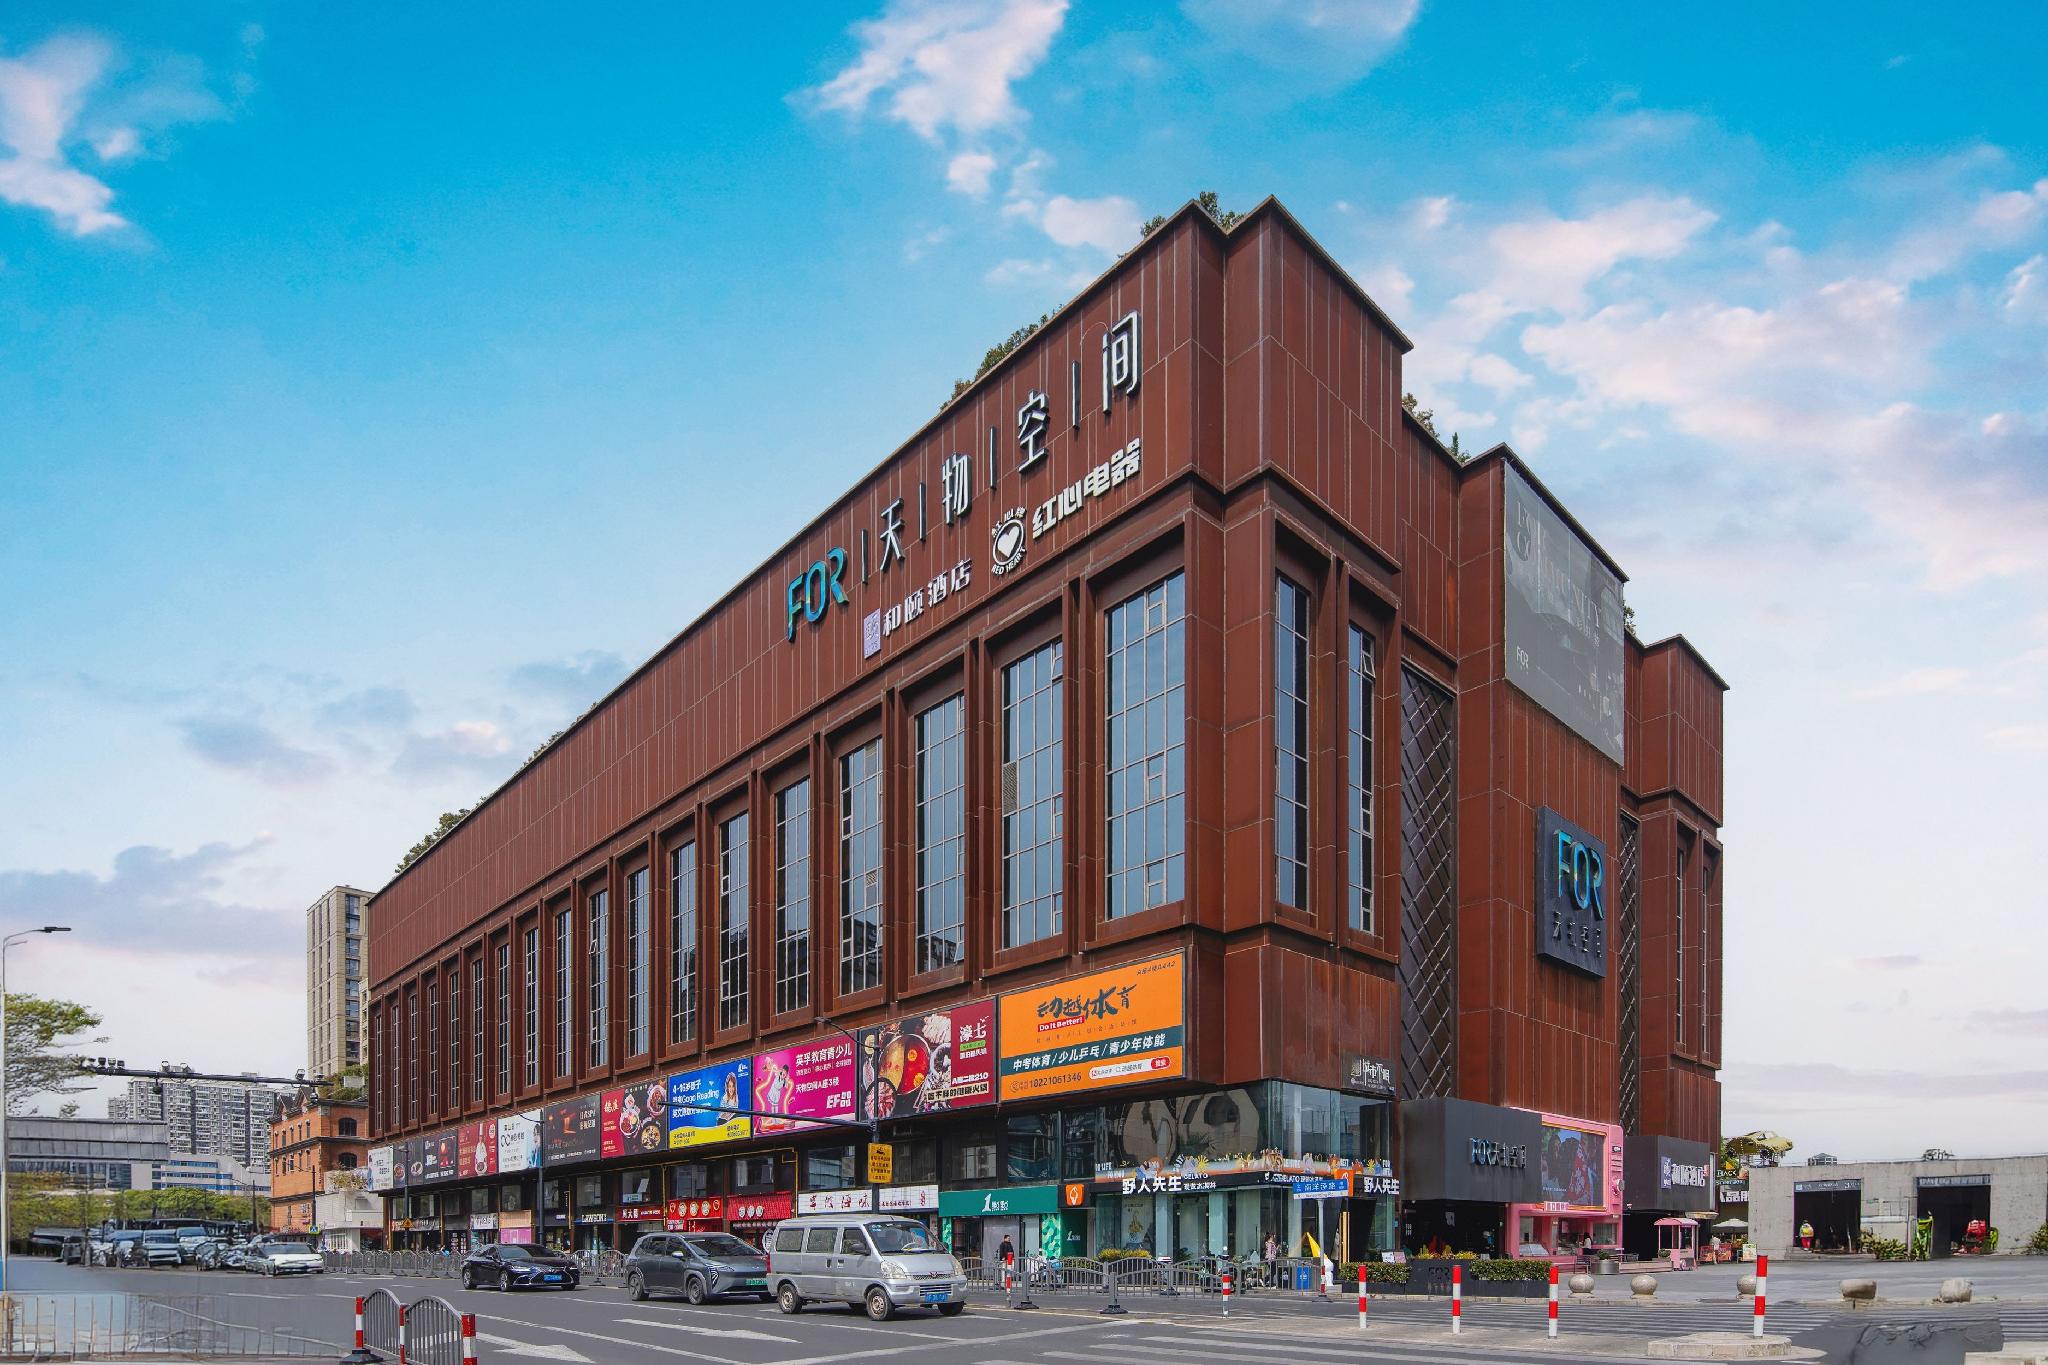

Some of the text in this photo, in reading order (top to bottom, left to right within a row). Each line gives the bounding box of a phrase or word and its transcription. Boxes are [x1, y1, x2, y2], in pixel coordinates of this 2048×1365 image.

[1032, 437, 1141, 540] 红心电器
[1006, 547, 1026, 572] HEART
[786, 546, 849, 642] FOR
[883, 557, 973, 638] 和颐酒店
[1554, 829, 1605, 920] FOR
[1037, 984, 1137, 1019] 动越体育
[795, 1042, 853, 1067] 英孚教育青少儿
[1122, 1176, 1182, 1195] 野人先生
[1363, 1177, 1400, 1195] 野人先生
